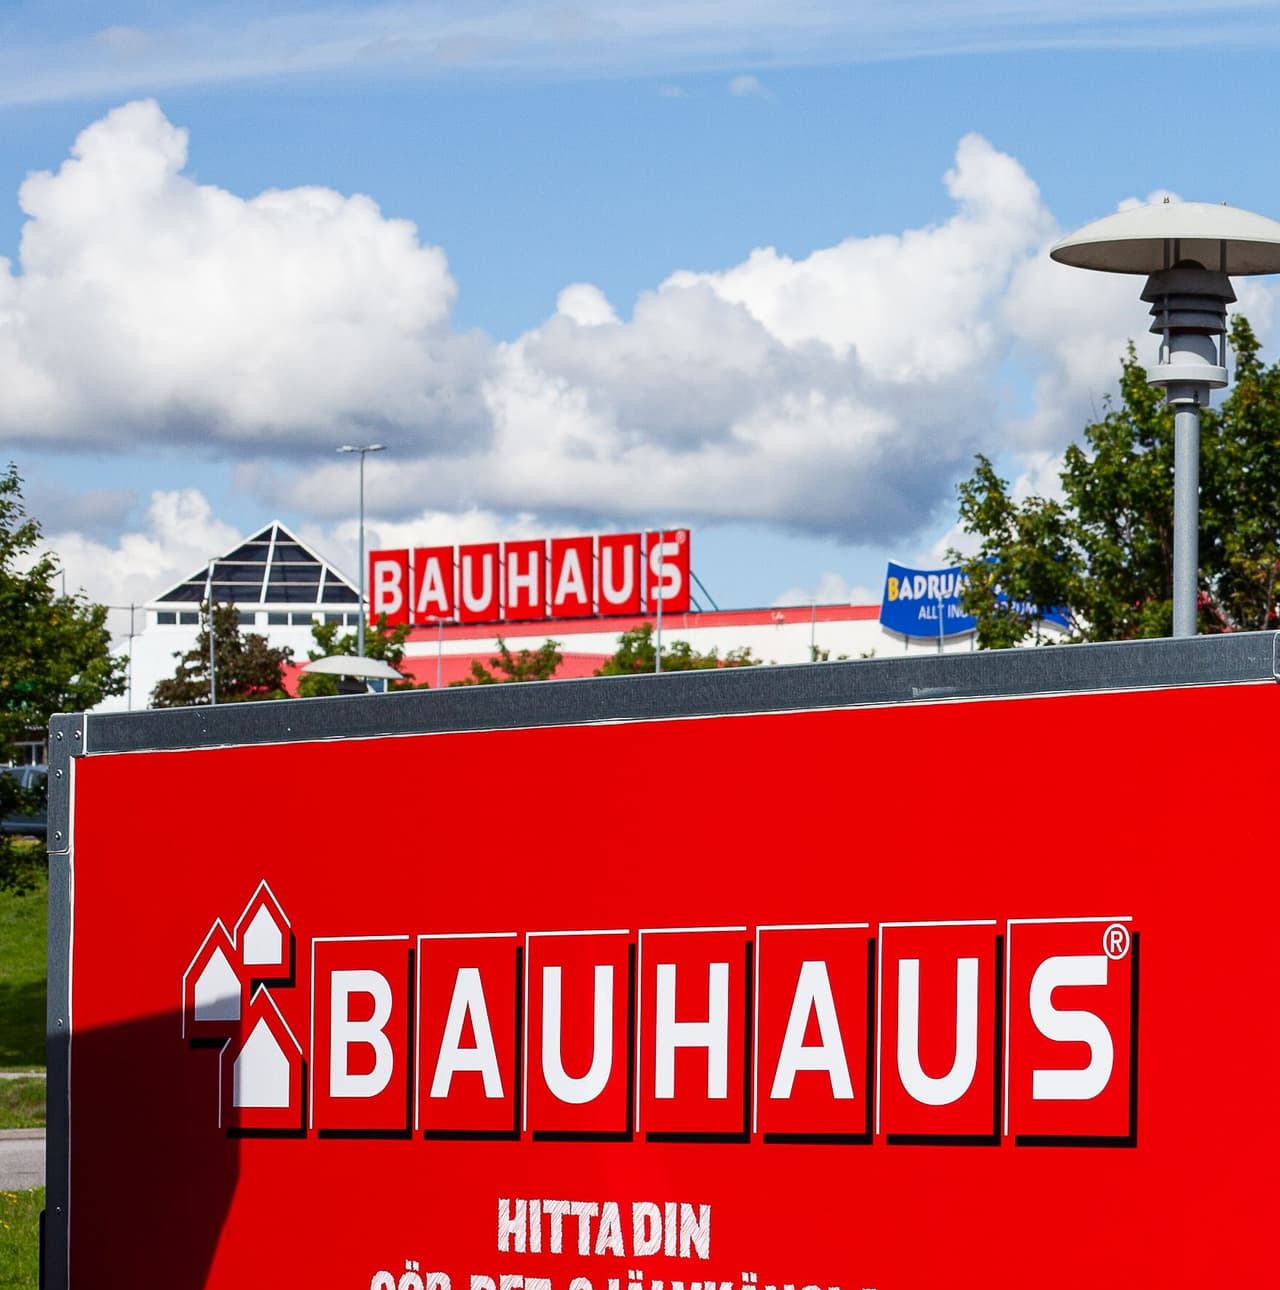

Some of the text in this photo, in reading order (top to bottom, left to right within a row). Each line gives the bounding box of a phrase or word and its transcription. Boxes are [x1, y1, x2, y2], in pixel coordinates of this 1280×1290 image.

[374, 542, 682, 615] BAUHAUS
[330, 956, 1115, 1107] BAUHAUS
[497, 1198, 711, 1261] HITTA DIN
